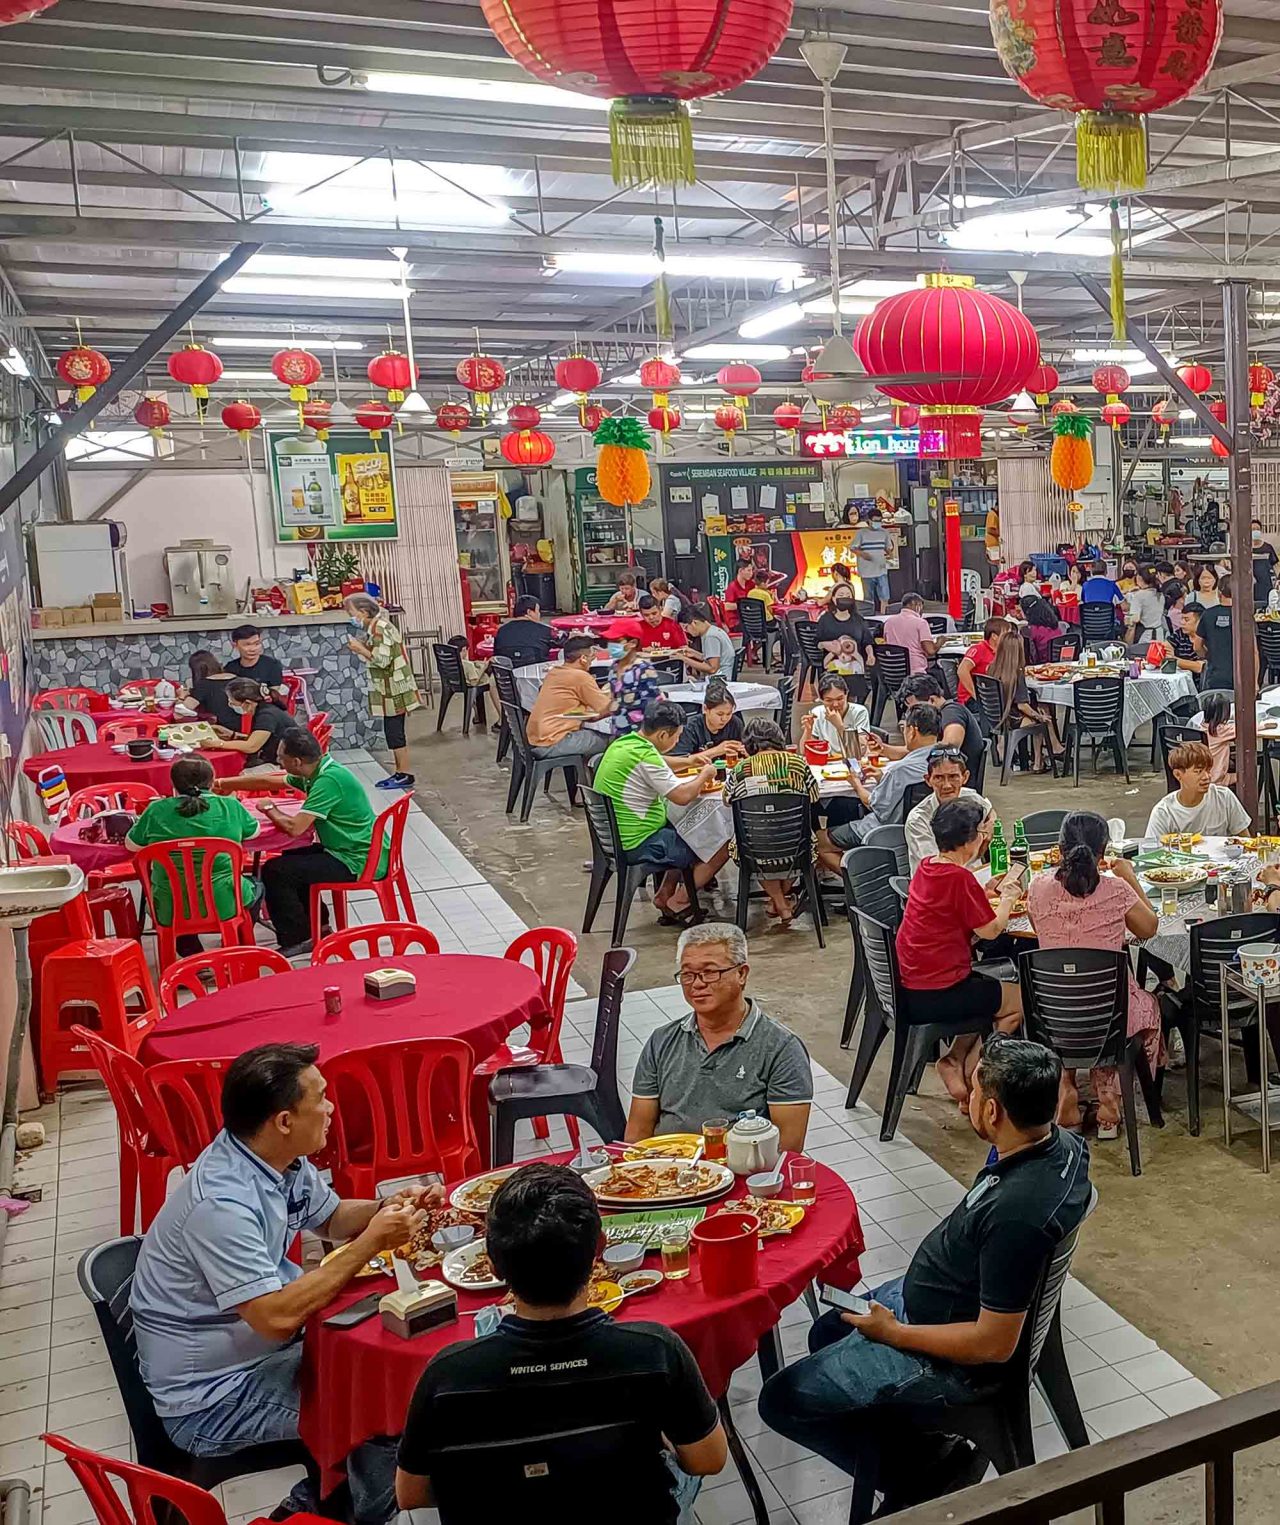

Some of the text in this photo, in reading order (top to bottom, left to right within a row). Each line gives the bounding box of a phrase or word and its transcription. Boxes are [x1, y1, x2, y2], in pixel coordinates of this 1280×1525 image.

[691, 468, 717, 478] SEREMBAN
[717, 467, 738, 477] SEAFOOD
[738, 467, 757, 477] VILLAGE
[510, 1358, 588, 1375] WINTECH SERVICES
